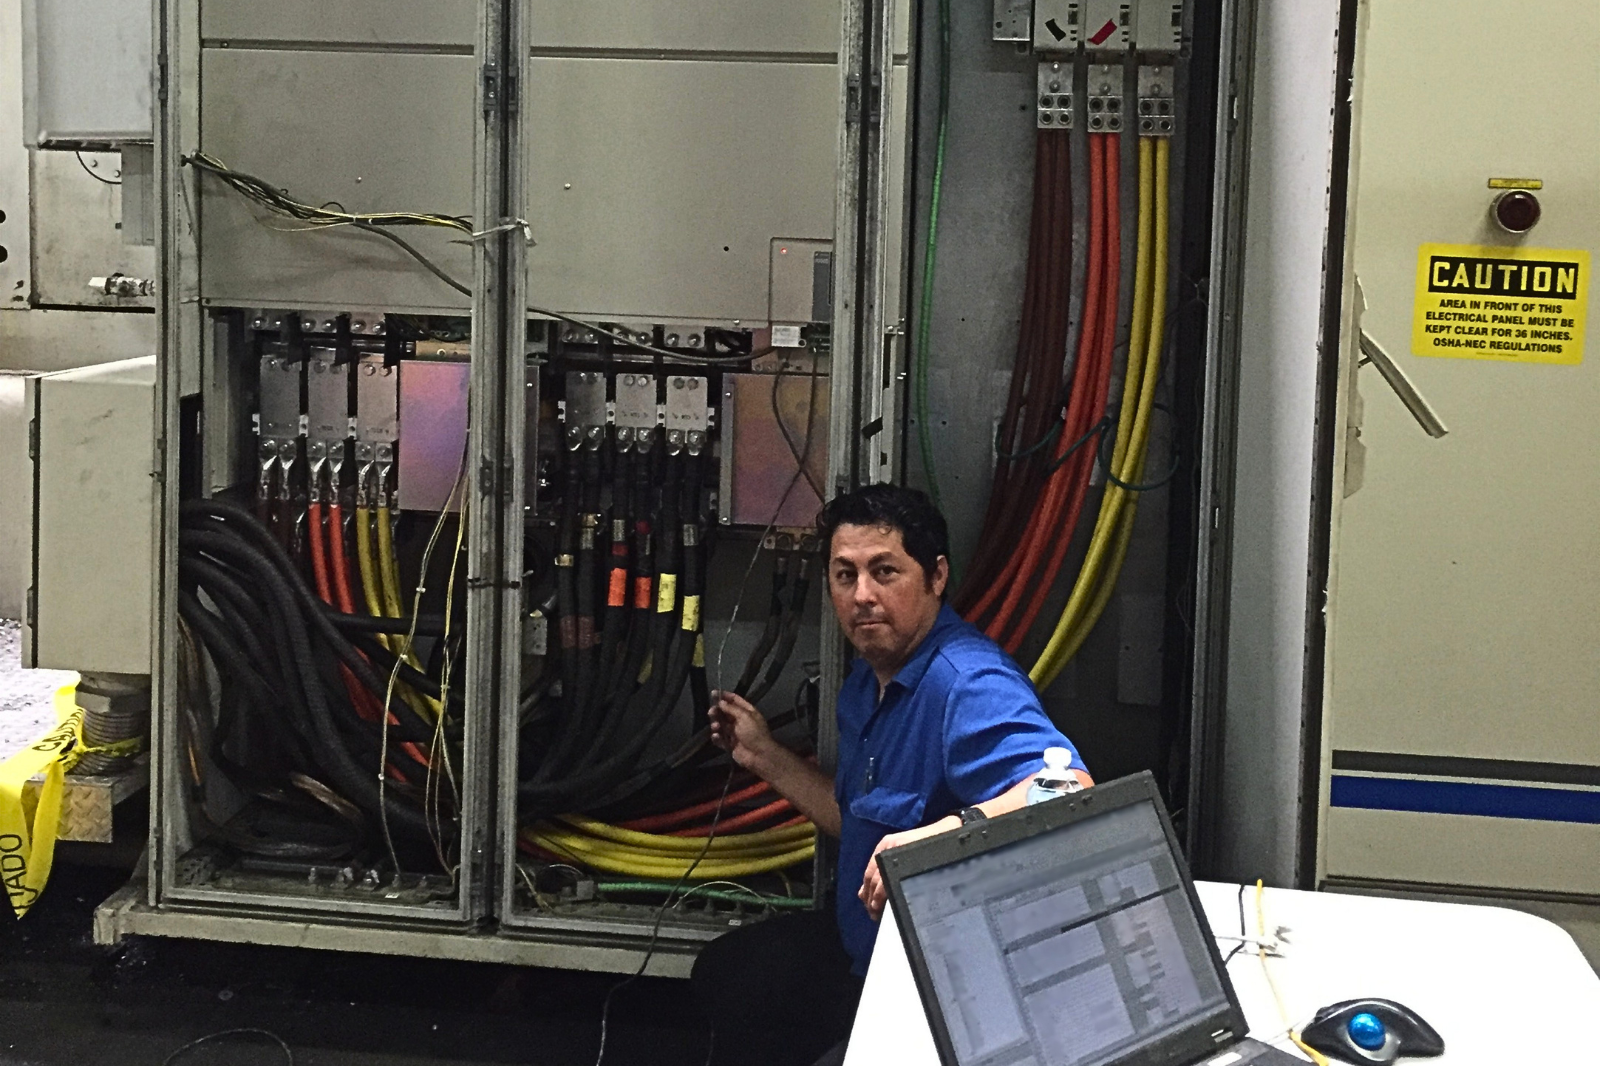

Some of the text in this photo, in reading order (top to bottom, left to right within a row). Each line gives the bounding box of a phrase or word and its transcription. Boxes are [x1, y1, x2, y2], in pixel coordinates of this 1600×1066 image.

[1432, 261, 1575, 293] CAUTION
[1439, 299, 1563, 314] AREA IN FRONT OF THIS
[1426, 311, 1575, 328] ELECTRICAL PANEL MUST BE
[1425, 324, 1574, 341] KEPT CLEAR FOR 36 INCHES.
[1433, 337, 1563, 354] OSHA-NEC REGULATIONS
